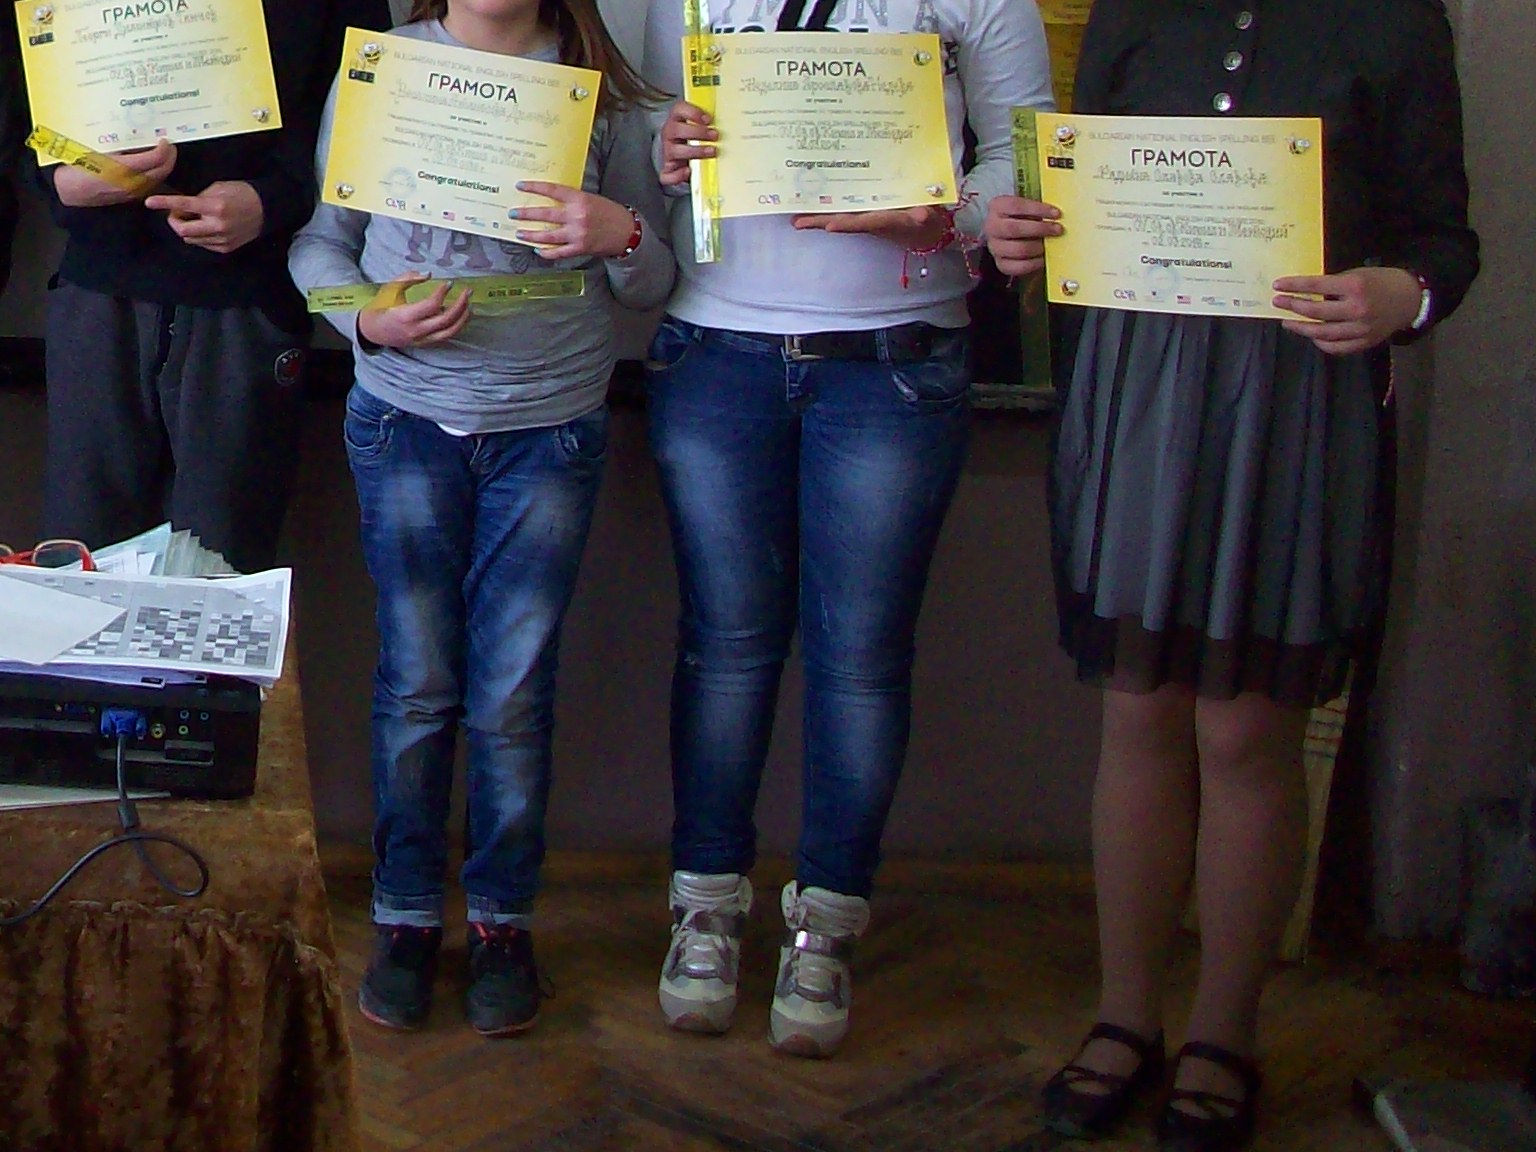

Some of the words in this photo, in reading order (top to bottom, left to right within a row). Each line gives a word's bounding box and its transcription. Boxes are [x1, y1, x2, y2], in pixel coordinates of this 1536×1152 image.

[775, 60, 866, 78] ГРАМОТА
[427, 71, 518, 104] ГРАМОТА
[119, 88, 200, 108] Congratulations!
[785, 158, 870, 170] Congratulations!
[1131, 148, 1232, 169] ГРАМОТА
[417, 169, 500, 195] Congratulations!
[1140, 255, 1233, 270] Congratulations!
